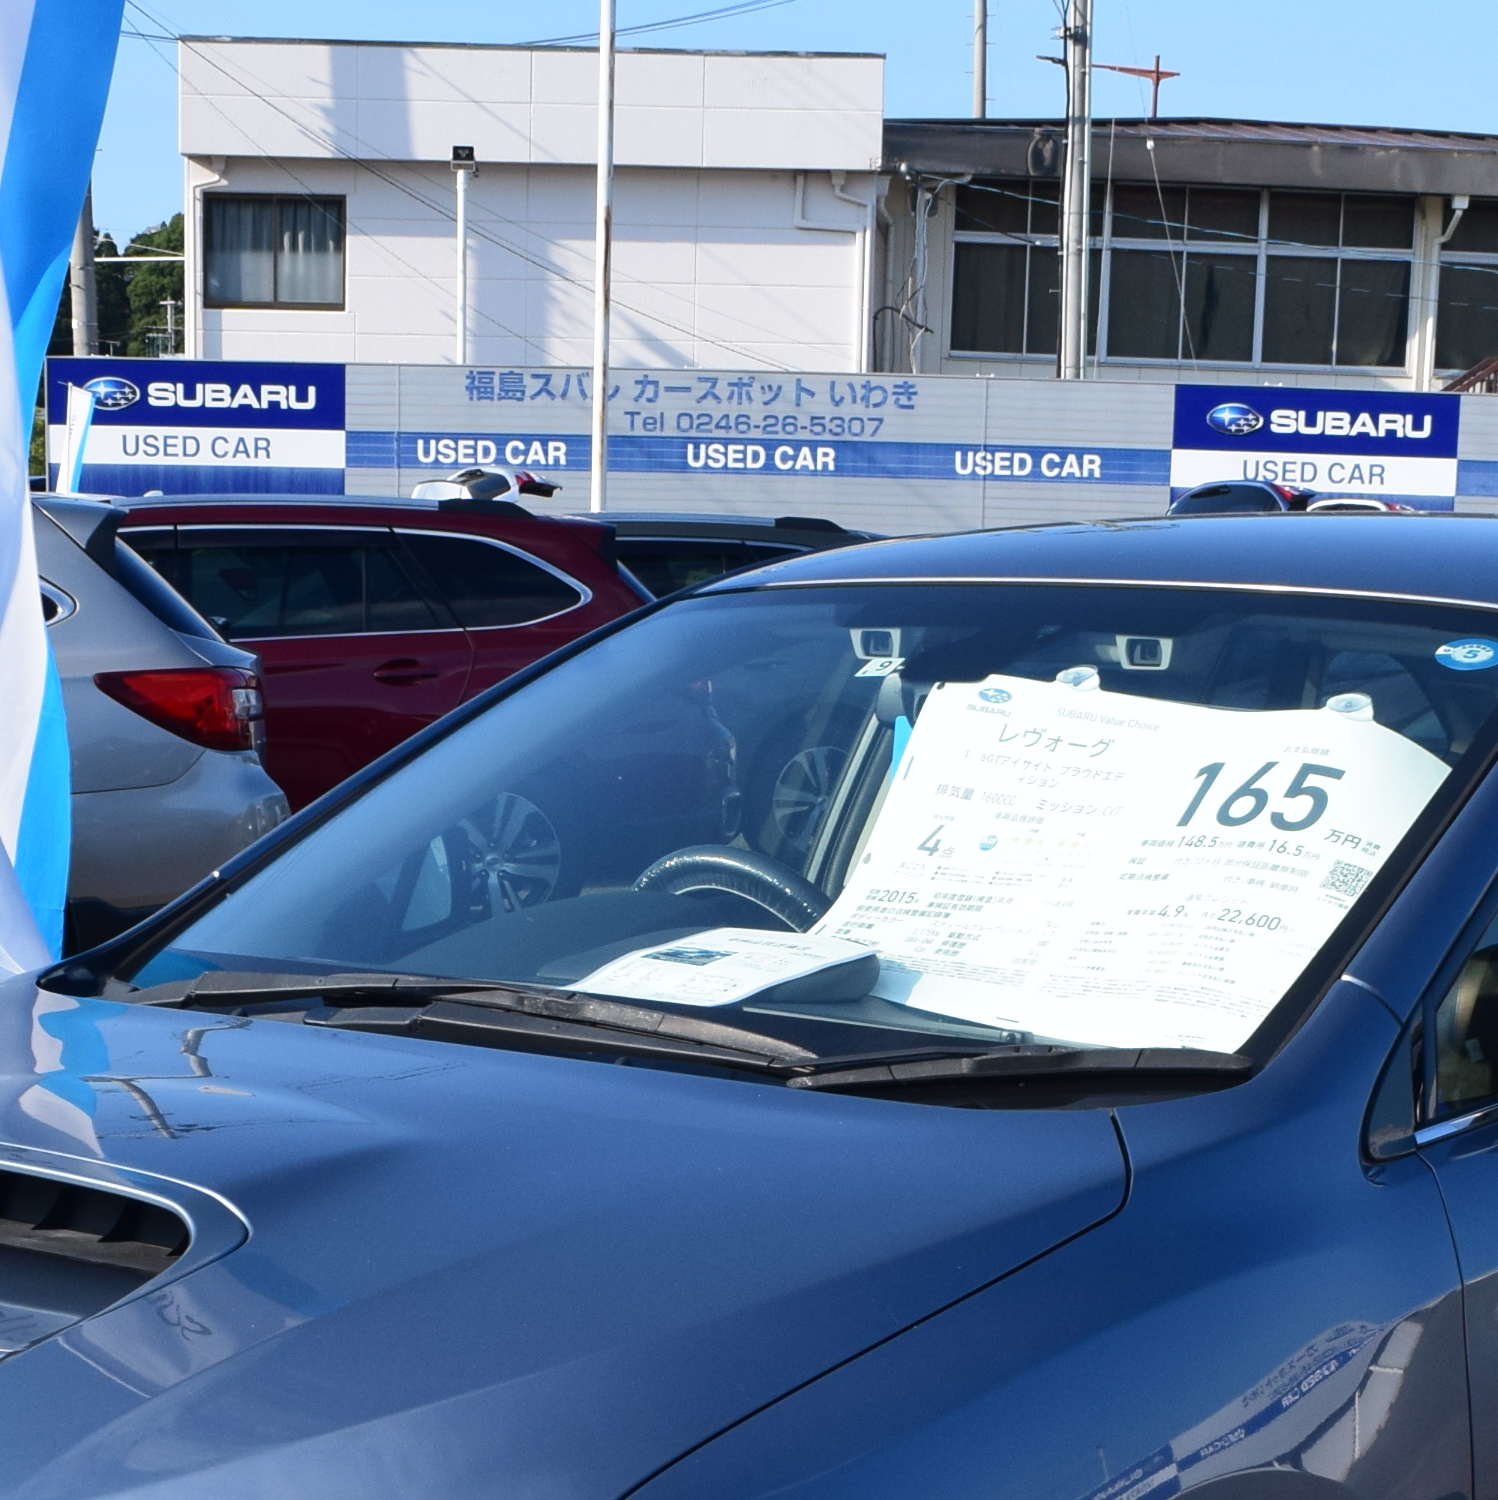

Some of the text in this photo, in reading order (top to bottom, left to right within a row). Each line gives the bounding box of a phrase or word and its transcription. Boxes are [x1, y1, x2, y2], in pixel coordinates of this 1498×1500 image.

[147, 382, 316, 410] SUBARU
[623, 410, 885, 438] Tel 0246-26-5307
[1270, 409, 1432, 439] SUBARU
[122, 434, 272, 460] USED CAR
[417, 438, 568, 466] USED CAR
[687, 442, 836, 472] USED CAR
[954, 450, 1102, 478] USED CAR
[1242, 459, 1386, 486] USED CAR
[966, 703, 1012, 717] SUBARU
[1056, 707, 1161, 732] SUBARU Value Choice
[998, 722, 1116, 758] レヴォーグ
[1036, 798, 1099, 817] ミッション
[1175, 760, 1347, 832] 165
[916, 824, 947, 857] 4
